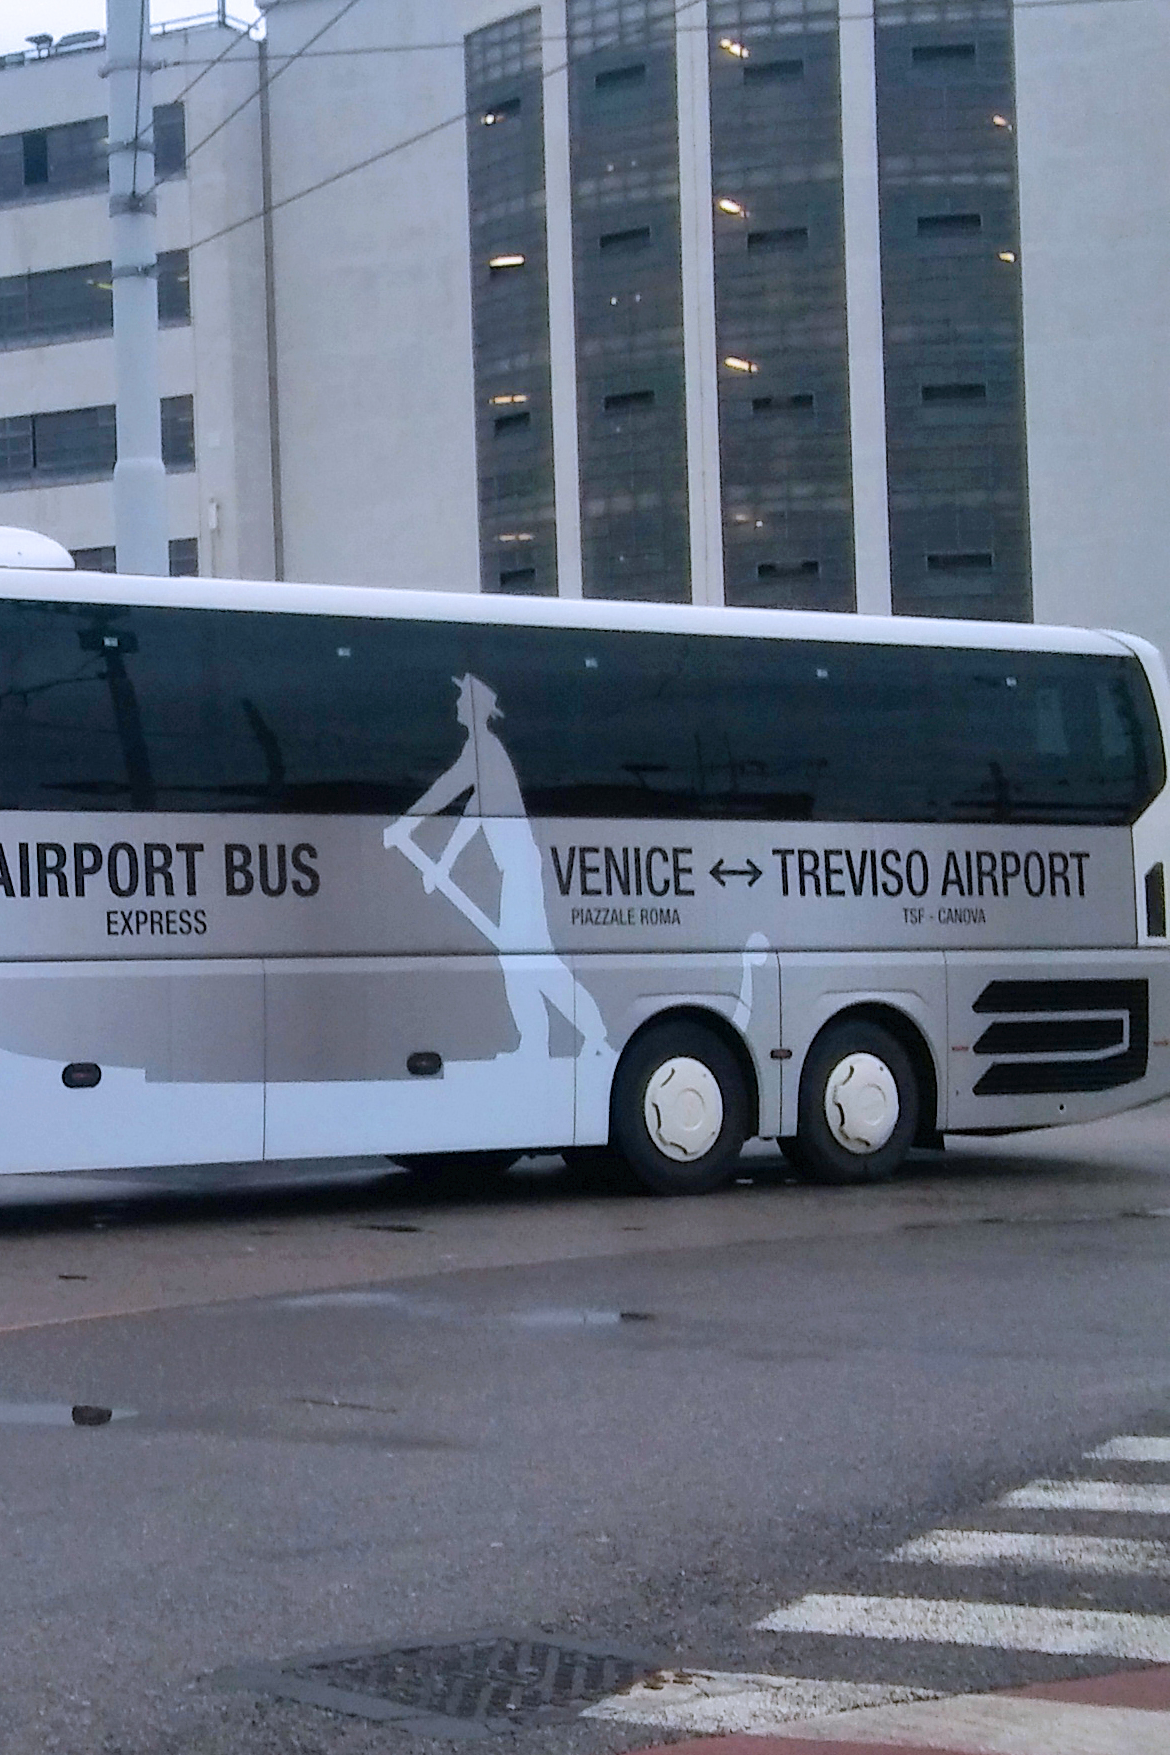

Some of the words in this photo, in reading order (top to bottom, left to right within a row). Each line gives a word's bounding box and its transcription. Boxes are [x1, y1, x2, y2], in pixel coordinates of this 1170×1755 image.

[224, 842, 321, 898] BUS
[550, 846, 695, 897] VENICE
[771, 848, 929, 897] TREVISO
[941, 850, 1090, 897] AIRPORT
[106, 910, 207, 936] EXPRESS
[571, 907, 635, 926] PIAZZALE
[640, 907, 681, 926] ROMA
[902, 907, 925, 924] TSF
[938, 907, 986, 924] CANOVA
